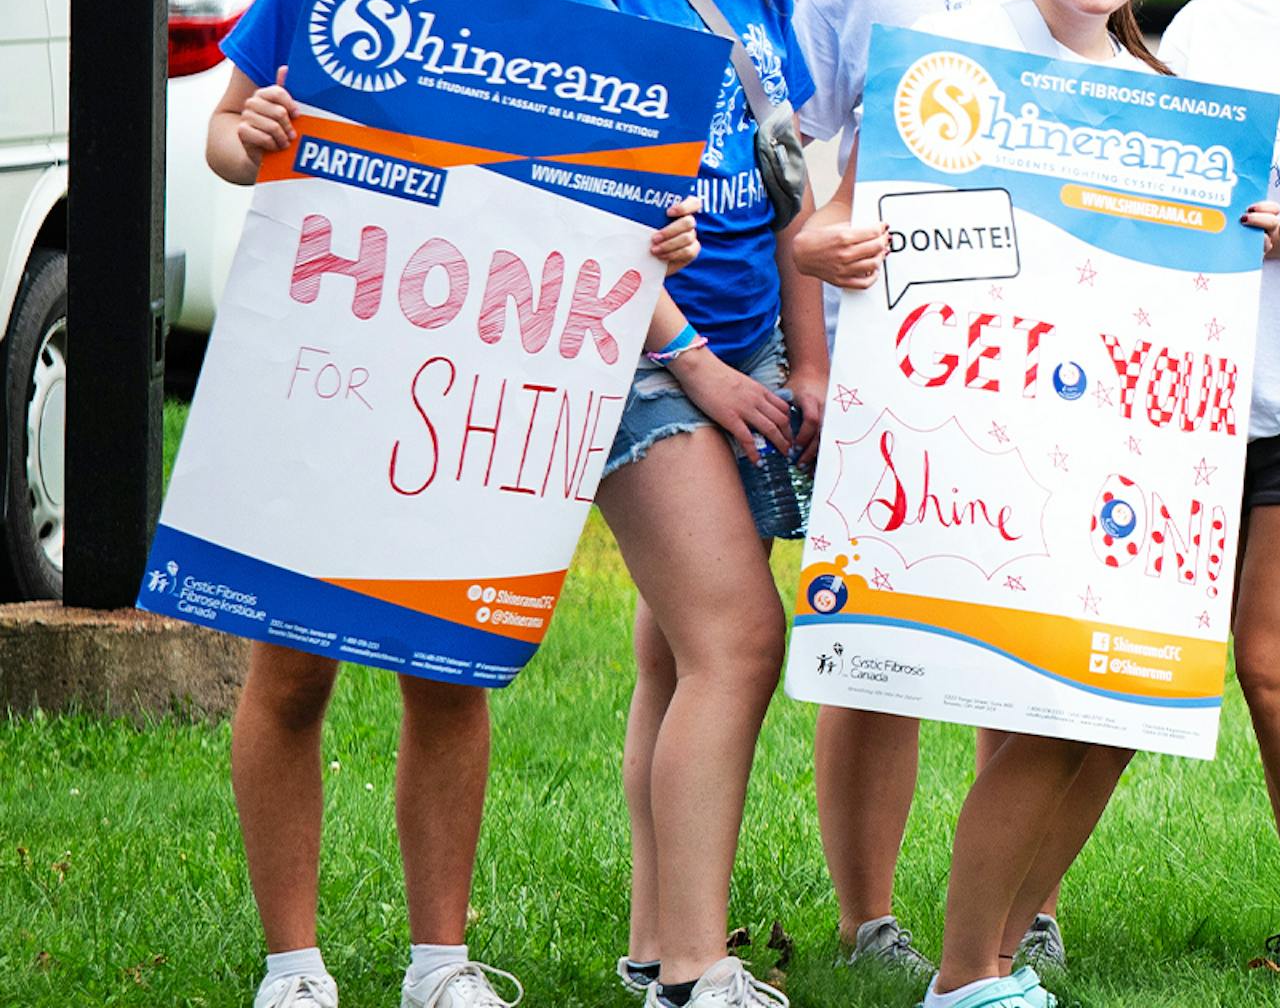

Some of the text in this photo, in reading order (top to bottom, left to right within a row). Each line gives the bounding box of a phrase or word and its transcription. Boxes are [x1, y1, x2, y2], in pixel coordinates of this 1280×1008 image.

[1020, 71, 1248, 122] CYSTIC FIBROSIS CANADA'S
[921, 77, 1233, 184] Shinerama
[300, 141, 442, 200] PARTICIPEZ!
[995, 154, 1227, 203] STUDENTS FIGHTING CYSTIC FIBROSIS
[1081, 191, 1204, 227] WWW.SHINERAMA.CA
[890, 226, 1012, 253] DONATE!
[289, 214, 642, 365] HONK
[895, 301, 1238, 435] GET YOUR
[288, 346, 624, 503] FOR SHINE
[857, 430, 1024, 542] Shine
[1090, 473, 1227, 599] ON!
[177, 599, 217, 620] Canada
[851, 667, 889, 684] Canada
